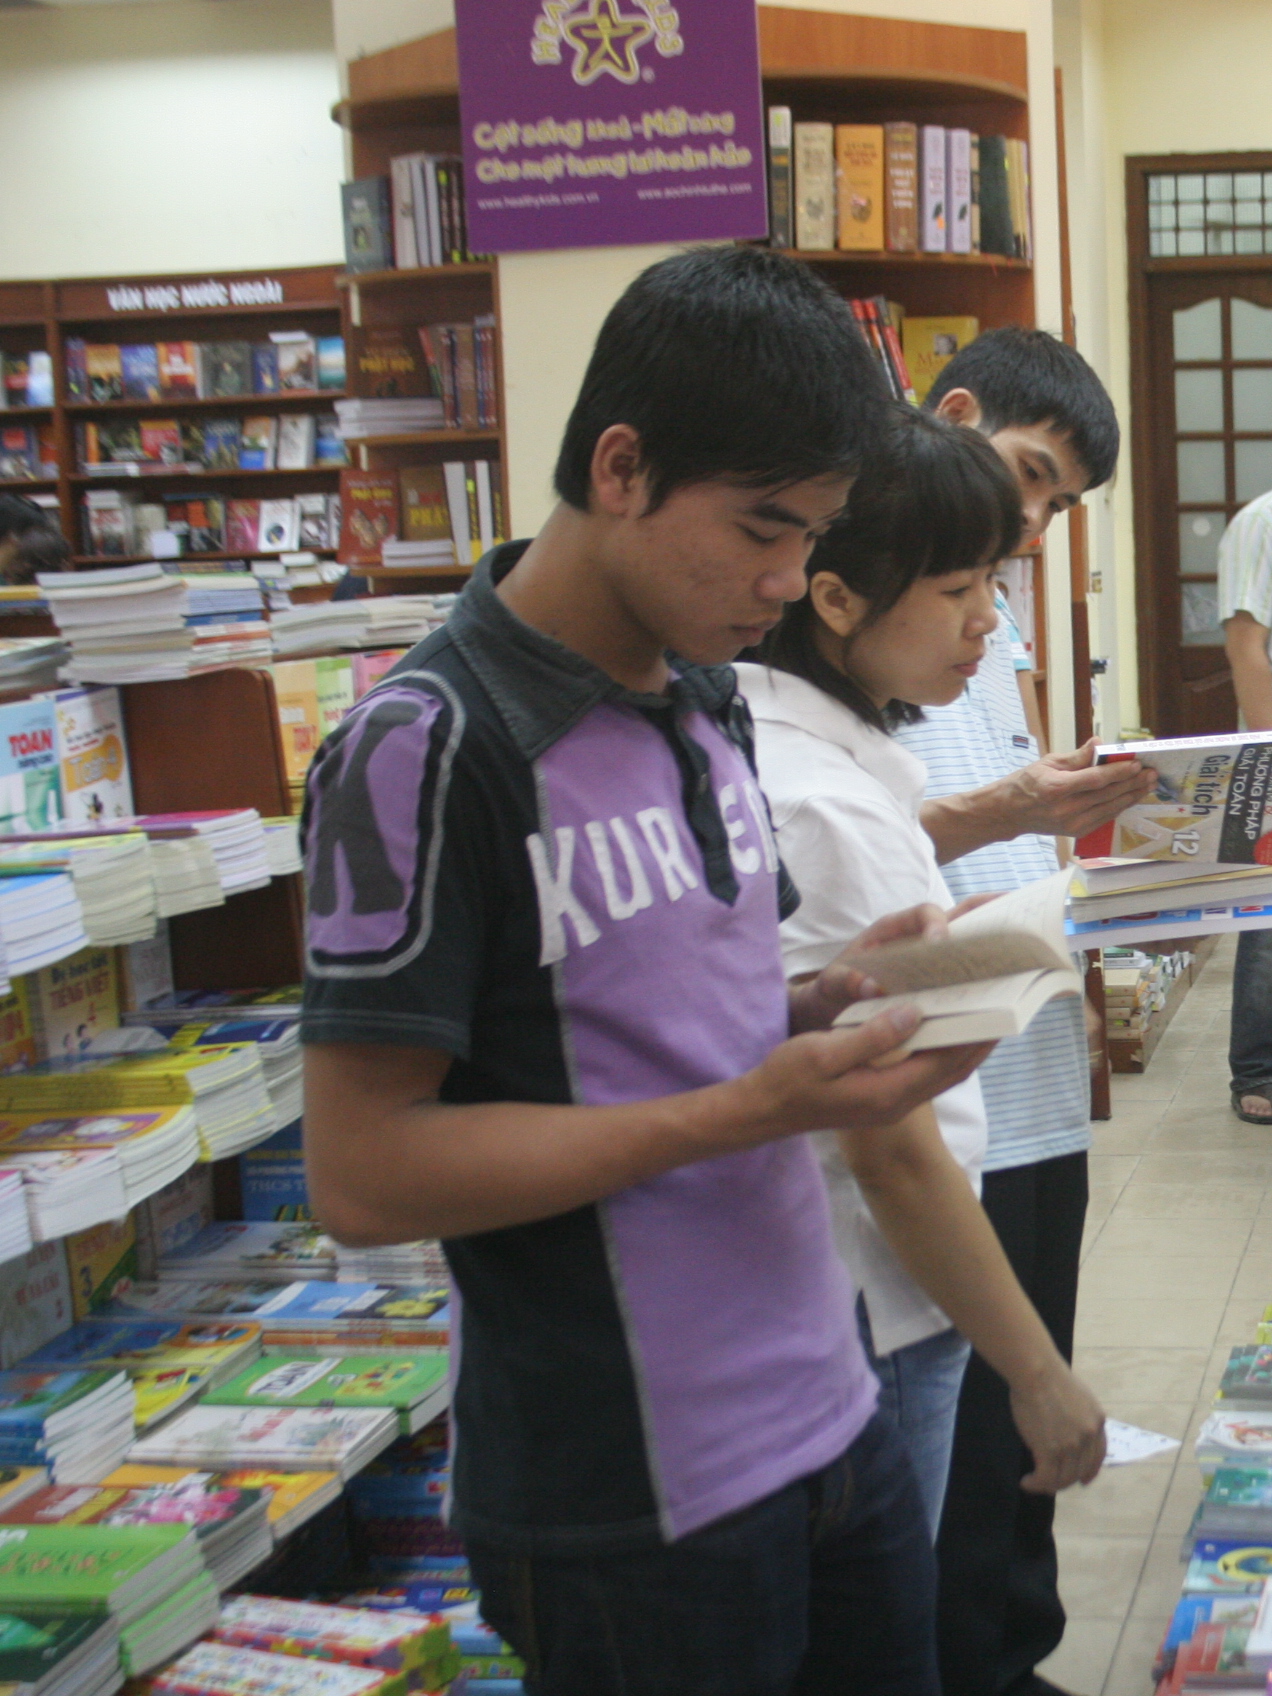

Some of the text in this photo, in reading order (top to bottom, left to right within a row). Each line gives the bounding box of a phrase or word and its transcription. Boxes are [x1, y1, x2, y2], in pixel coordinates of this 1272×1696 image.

[1191, 754, 1233, 817] Giải tích
[1228, 748, 1258, 816] GIẢI TOÁN
[1171, 829, 1202, 856] 12
[1244, 800, 1263, 841] PHÁP
